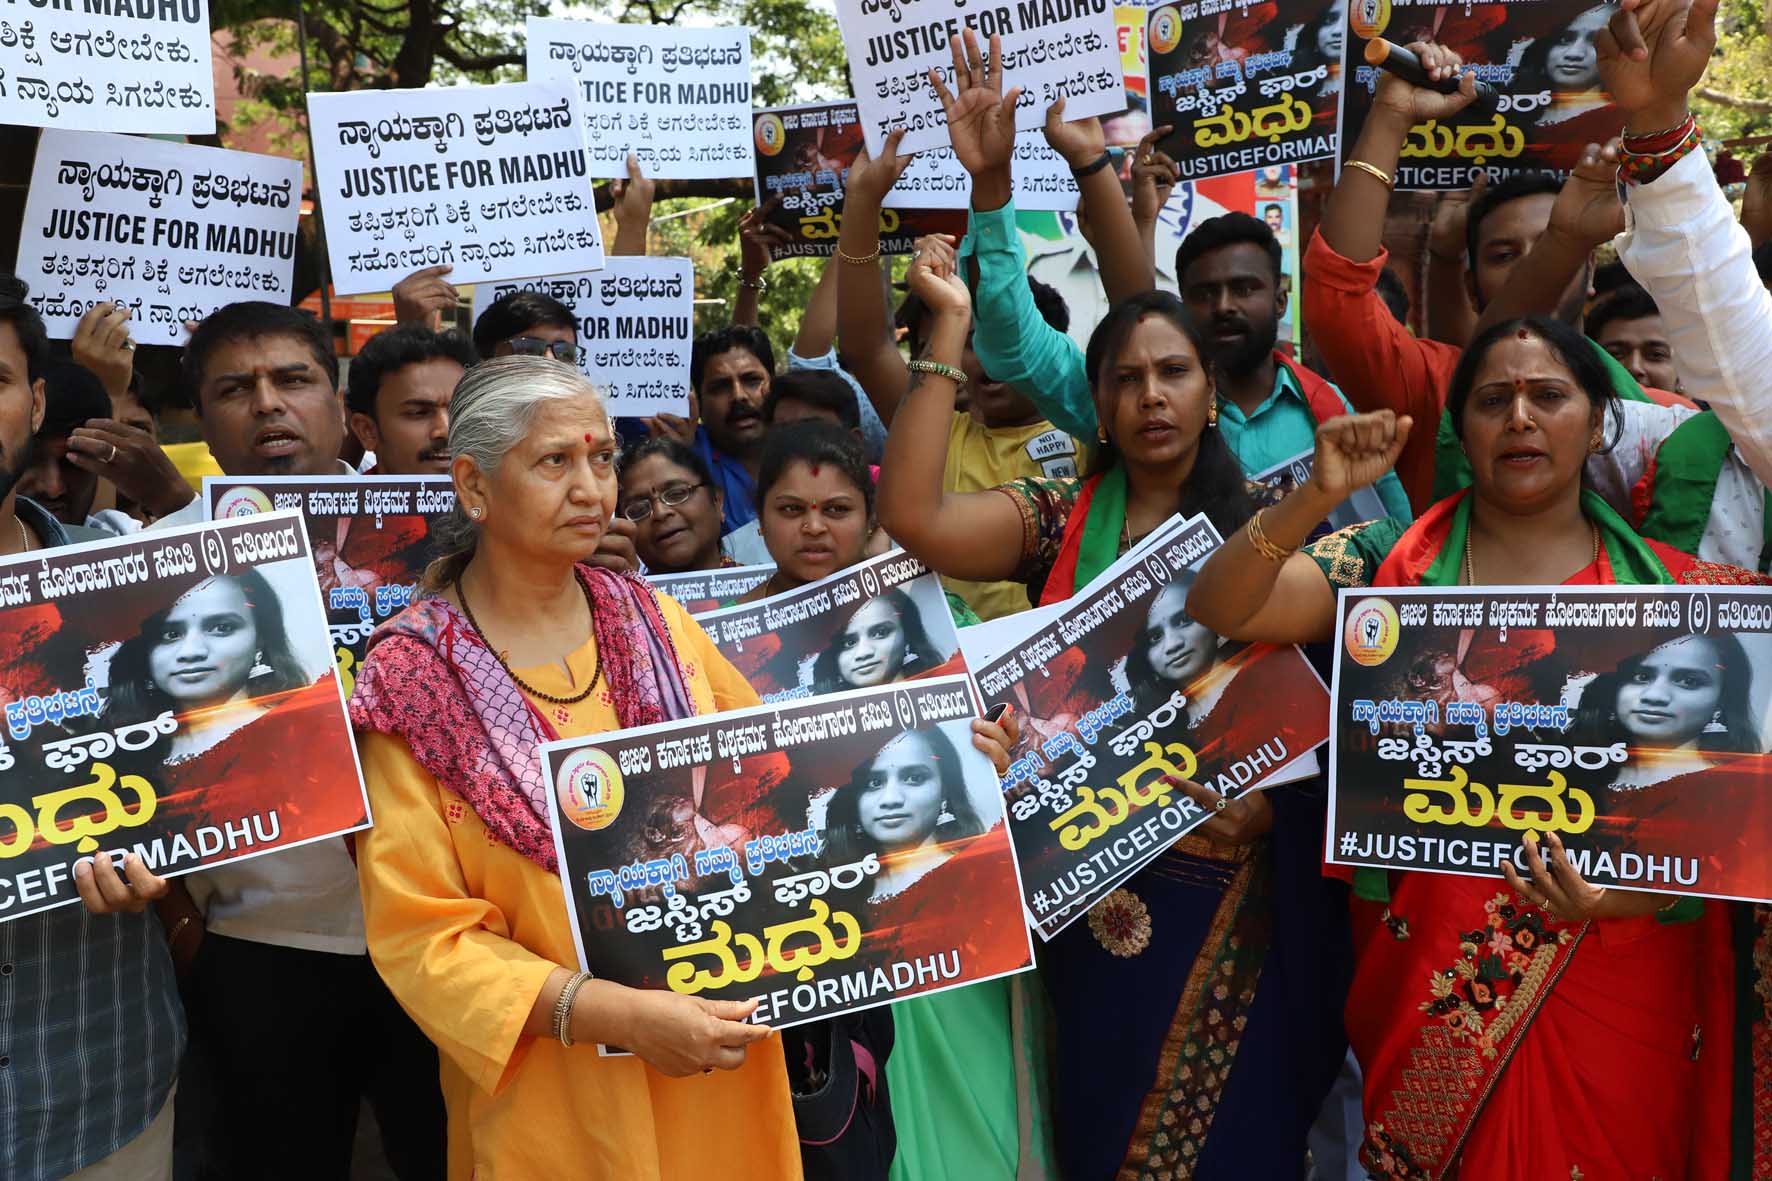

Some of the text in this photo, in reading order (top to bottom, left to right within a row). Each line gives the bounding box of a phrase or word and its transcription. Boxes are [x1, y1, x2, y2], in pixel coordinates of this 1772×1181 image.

[50, 28, 199, 64] ಆಗಲೇಬೇಕು.
[549, 39, 742, 75] ನ್ಯಾಯಕ್ಕಾಗಿ ಪ್ರತಿಭಟನೆ
[866, 19, 958, 67] JUSTICE
[965, 7, 1014, 40] FOR
[1018, 0, 1107, 32] MADHU
[1000, 28, 1108, 71] ಆಗಲೇಬೇಕು.
[16, 76, 94, 118] ನ್ಯಾಯ
[105, 80, 210, 109] ಸಿಗಬೇಕು.
[579, 80, 749, 105] TICE FOR MADHU
[1042, 66, 1120, 103] ಸಿಗಬೇಕು.
[1175, 80, 1247, 117] ಜಸ್ಟಿಸ್
[1259, 64, 1328, 98] ಫಾರ್
[338, 97, 572, 159] ನ್ಯಾಯಕ್ಕಾಗಿ ಪ್ರತಿಭಟನೆ
[657, 112, 747, 133] ಆಗಲೇಬೇಕು.
[1193, 92, 1312, 149] ಮಧು
[1399, 113, 1525, 165] ಮಧು
[340, 149, 586, 199] JUSTICE FOR MADHU
[636, 147, 682, 173] ನ್ಯಾಯ
[688, 142, 752, 162] ಸಿಗಬೇಕು.
[1175, 133, 1338, 178] JUSTICEFORMAD
[57, 157, 292, 209] ನ್ಯಾಯಕ್ಕಾಗಿ ಪ್ರತಿಭಟನೆ
[43, 208, 295, 261] JUSTICE FOR MADHU
[348, 190, 588, 242] ತಪ್ಪಿತಸ್ಥರಿಗೆ ಶಿಕ್ಷೆ ಆಗಲೇಬೇಕು.
[41, 251, 286, 296] ತಪ್ಪಿತಸ್ಥರಿಗೆ ಶಿಕ್ಷೆ ಆಗಲೇಬೇಕು.
[348, 228, 600, 273] ಸಹೋದರಿಗೆ ನ್ಯಾಯ ಸಿಗಬೇಕು.
[600, 272, 682, 306] ಪ್ರತಿಭಟನೆ
[616, 317, 688, 340] MADHU
[595, 348, 686, 368] ಆಗಲೇಬೇಕು.
[1036, 441, 1067, 456] HAPPY
[1038, 433, 1056, 445] NOT
[1051, 465, 1071, 479] NEW
[309, 489, 358, 515] ಕರ್ನಾಟಕ
[364, 488, 411, 530] ವಿಶ್ವಕರ್ಮ
[38, 549, 149, 600] ಹೋರಾಟಗಾರರ
[154, 540, 197, 578] ಸಮಿತಿ
[200, 529, 229, 576] (ರಿ)
[232, 525, 299, 564] ವತಿಯಿಂದ
[833, 577, 861, 607] ಸಮಿತಿ
[861, 566, 881, 599] (ರಿ)
[1122, 571, 1153, 604] ಸಮಿತಿ
[1144, 553, 1172, 588] (ರಿ)
[330, 586, 371, 620] ನಮ್ಮ
[1400, 600, 1428, 628] ಅಖಿಲ
[1432, 599, 1484, 628] ಕರ್ನಾಟಕ
[1488, 598, 1538, 643] ವಿಶ್ವಕರ್ಮ
[1545, 591, 1637, 628] ಹೋರಾಟಗಾರರ
[1642, 597, 1681, 628] ಸಮಿತಿ
[1687, 593, 1712, 634] (ರಿ)
[5, 677, 102, 740] ಪ್ರತಿಭಟನೆ
[619, 689, 968, 777] ಅಖಿಲ ಕರ್ನಾಟಕ ವಿಶ್ವಕರ್ಮ ಹೋರಾಟಗಾರರ ಸಮಿತಿ (ರಿ) ವತಿಯಿಂದ
[1041, 732, 1087, 762] ನಮ್ಮ
[1075, 686, 1135, 745] ಪ್ರತಿಭಟನೆ
[1352, 696, 1571, 738] ನ್ಯಾಯಕ್ಕಾಗಿ ನಮ್ಮ ಪ್ರತಿಭಟನೆ
[42, 709, 179, 773] ಫಾರ್
[1011, 689, 1187, 822] ಜಸ್ಟಿಸ್ ಫಾರ್
[1377, 733, 1629, 778] ಜಸ್ಟಿಸ್ ಫಾರ್
[1049, 741, 1198, 852] ಮಧು
[1402, 765, 1596, 843] ಮಧು
[1032, 736, 1289, 915] #JUSTICEFORADHU
[588, 820, 825, 908] ನ್ಯಾಯಕ್ಕಾಗಿ ನಮ್ಮ ಪ್ರತಿಭಟನೆ
[624, 851, 881, 944] ಜಸ್ಟಿಸ್ ಫಾರ್
[661, 898, 863, 996] ಮಧು
